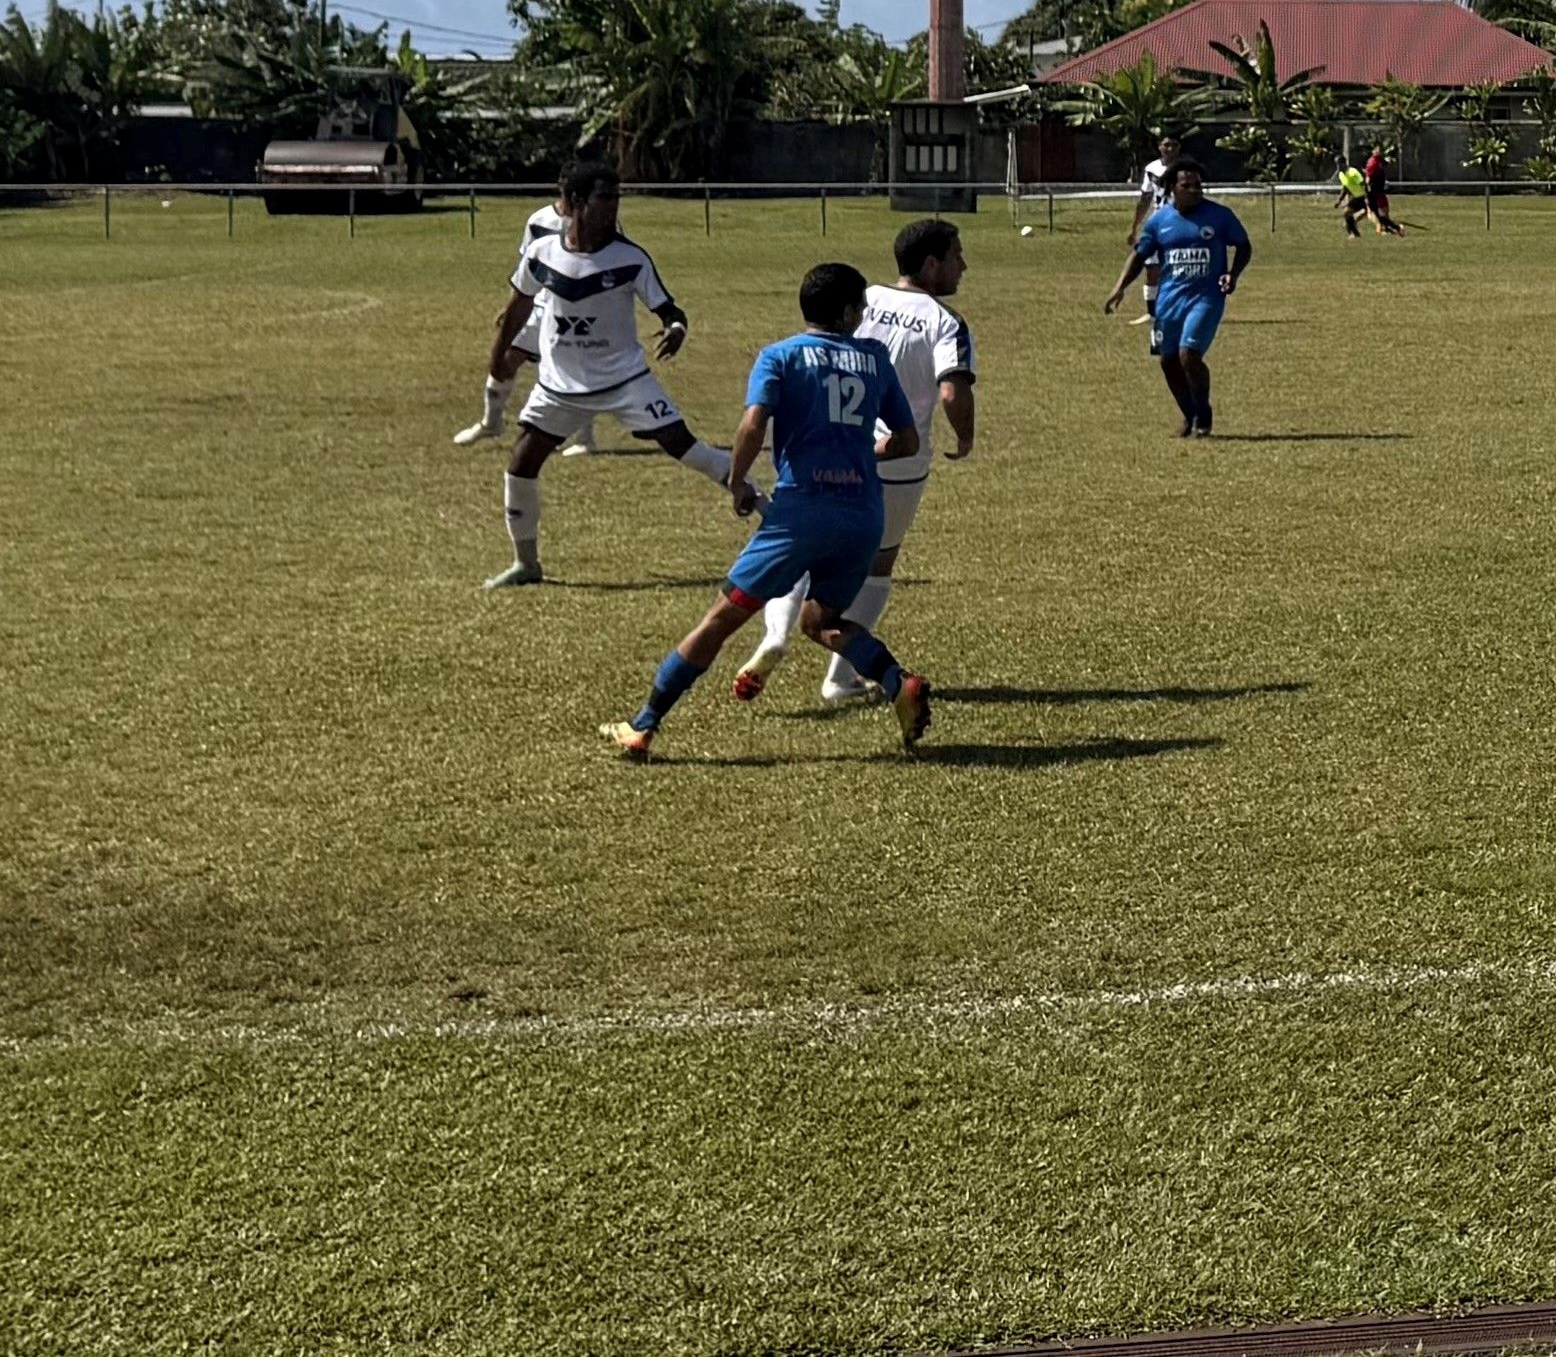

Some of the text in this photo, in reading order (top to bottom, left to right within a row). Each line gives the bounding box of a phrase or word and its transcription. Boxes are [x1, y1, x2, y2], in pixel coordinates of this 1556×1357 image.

[869, 307, 927, 333] VENUS
[645, 400, 673, 419] 12
[823, 373, 866, 426] 12
